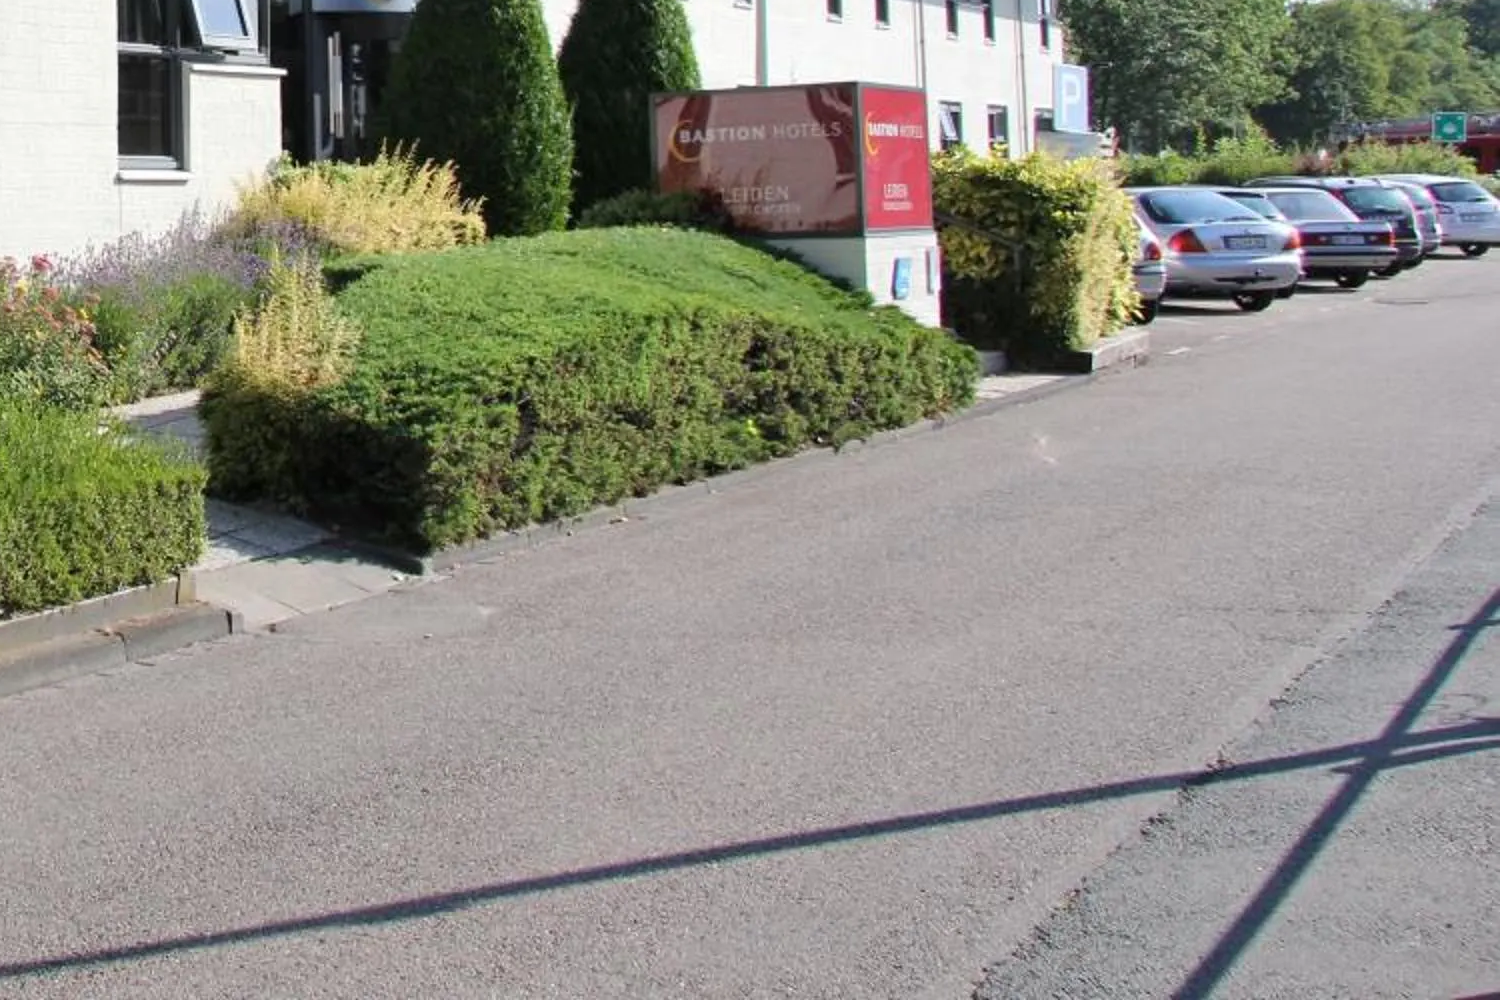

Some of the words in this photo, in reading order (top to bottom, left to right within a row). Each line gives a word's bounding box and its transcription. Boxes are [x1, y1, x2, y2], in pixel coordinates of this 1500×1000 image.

[679, 124, 766, 143] BASTION
[773, 121, 842, 138] HOTELS
[721, 185, 789, 203] LEIDEN
